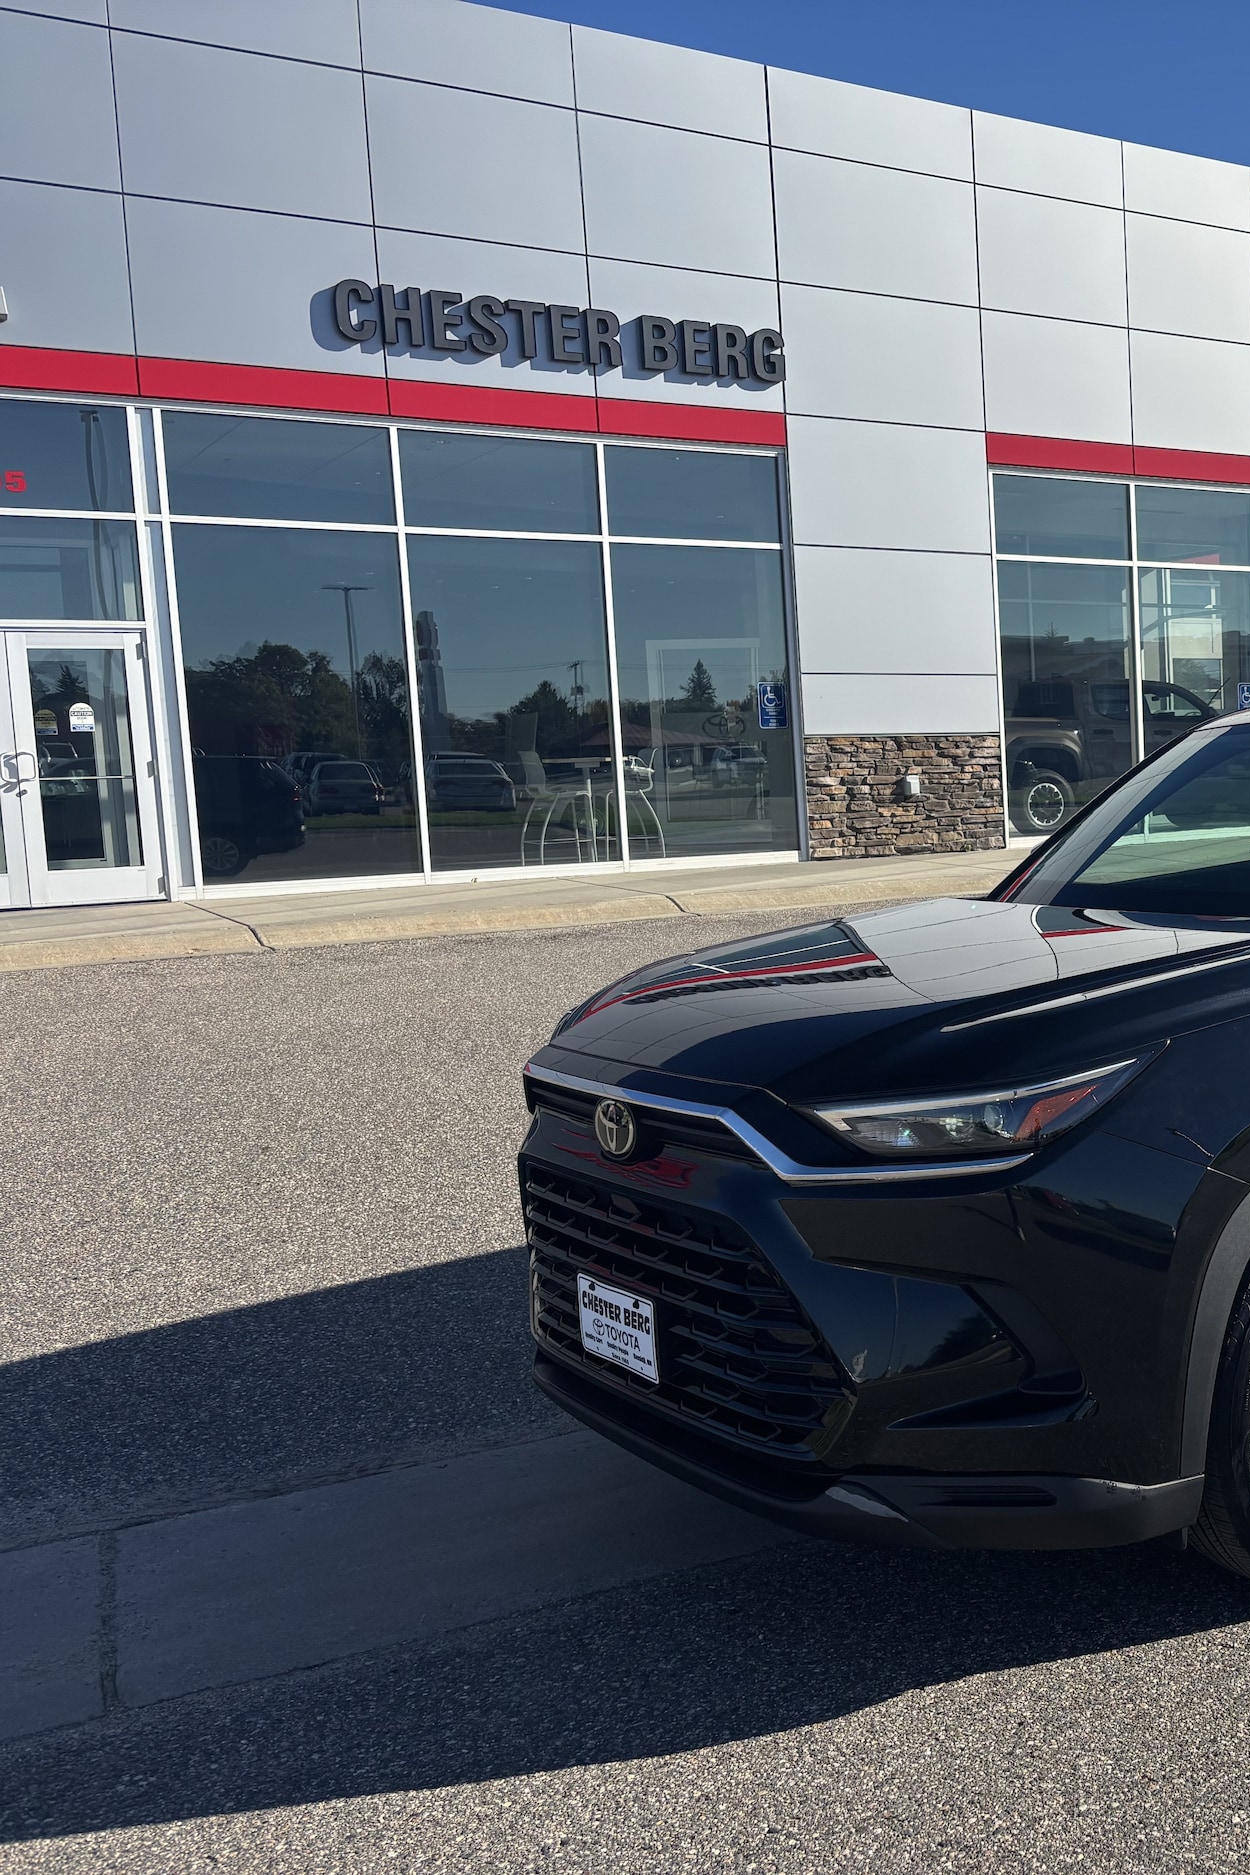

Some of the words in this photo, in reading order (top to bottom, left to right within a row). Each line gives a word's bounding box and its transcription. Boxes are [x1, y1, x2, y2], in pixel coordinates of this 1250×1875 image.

[335, 279, 623, 367] CHESTER
[641, 315, 786, 383] BERG
[0, 470, 27, 493] 5
[582, 1290, 622, 1323] CHESTER
[623, 1307, 651, 1335] BERG
[604, 1323, 641, 1352] TOYOTA
